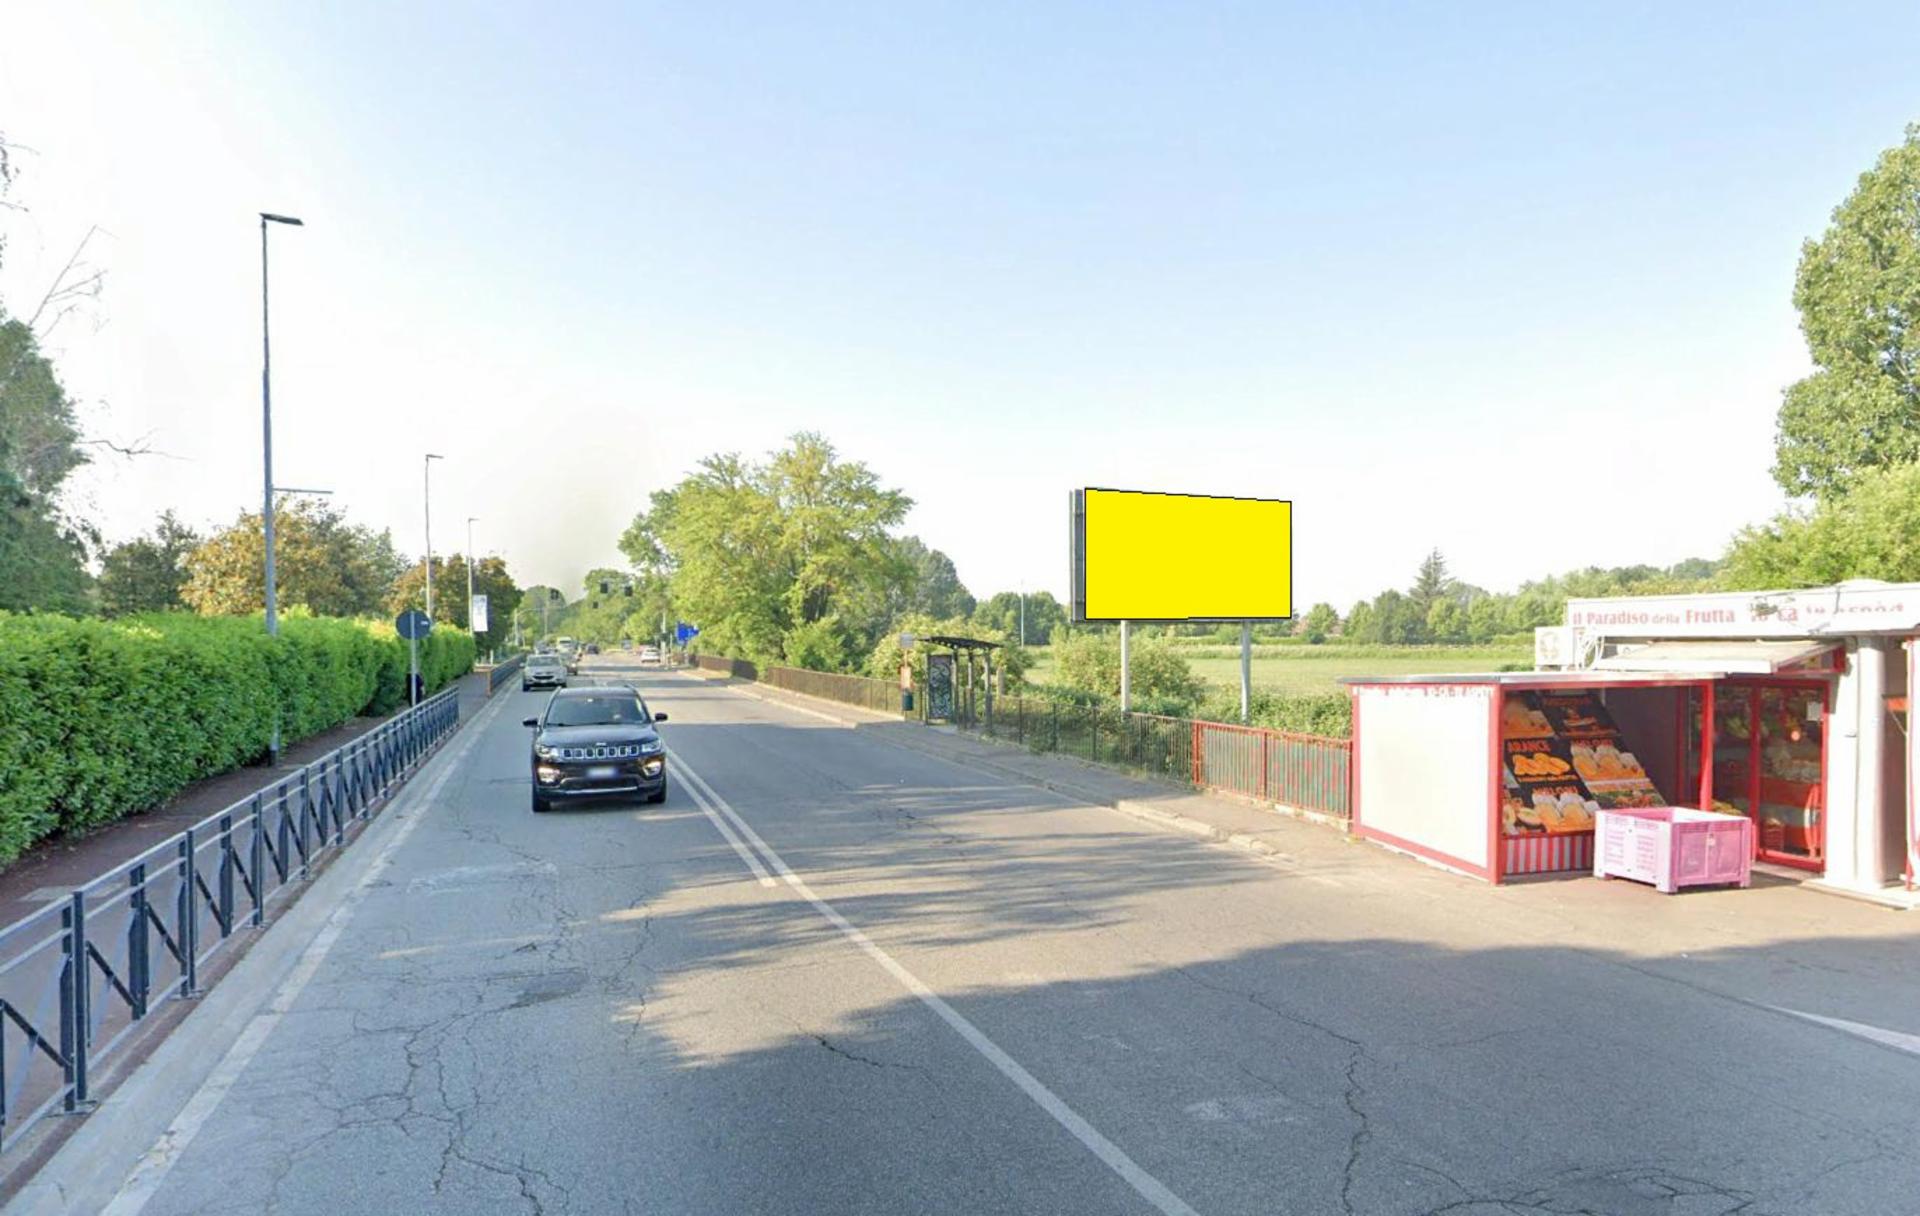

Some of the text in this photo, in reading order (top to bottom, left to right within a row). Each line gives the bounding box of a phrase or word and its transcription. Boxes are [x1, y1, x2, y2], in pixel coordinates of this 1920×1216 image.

[1586, 611, 1649, 625] Paradiso
[1652, 612, 1680, 624] della
[1686, 609, 1735, 624] Frutta
